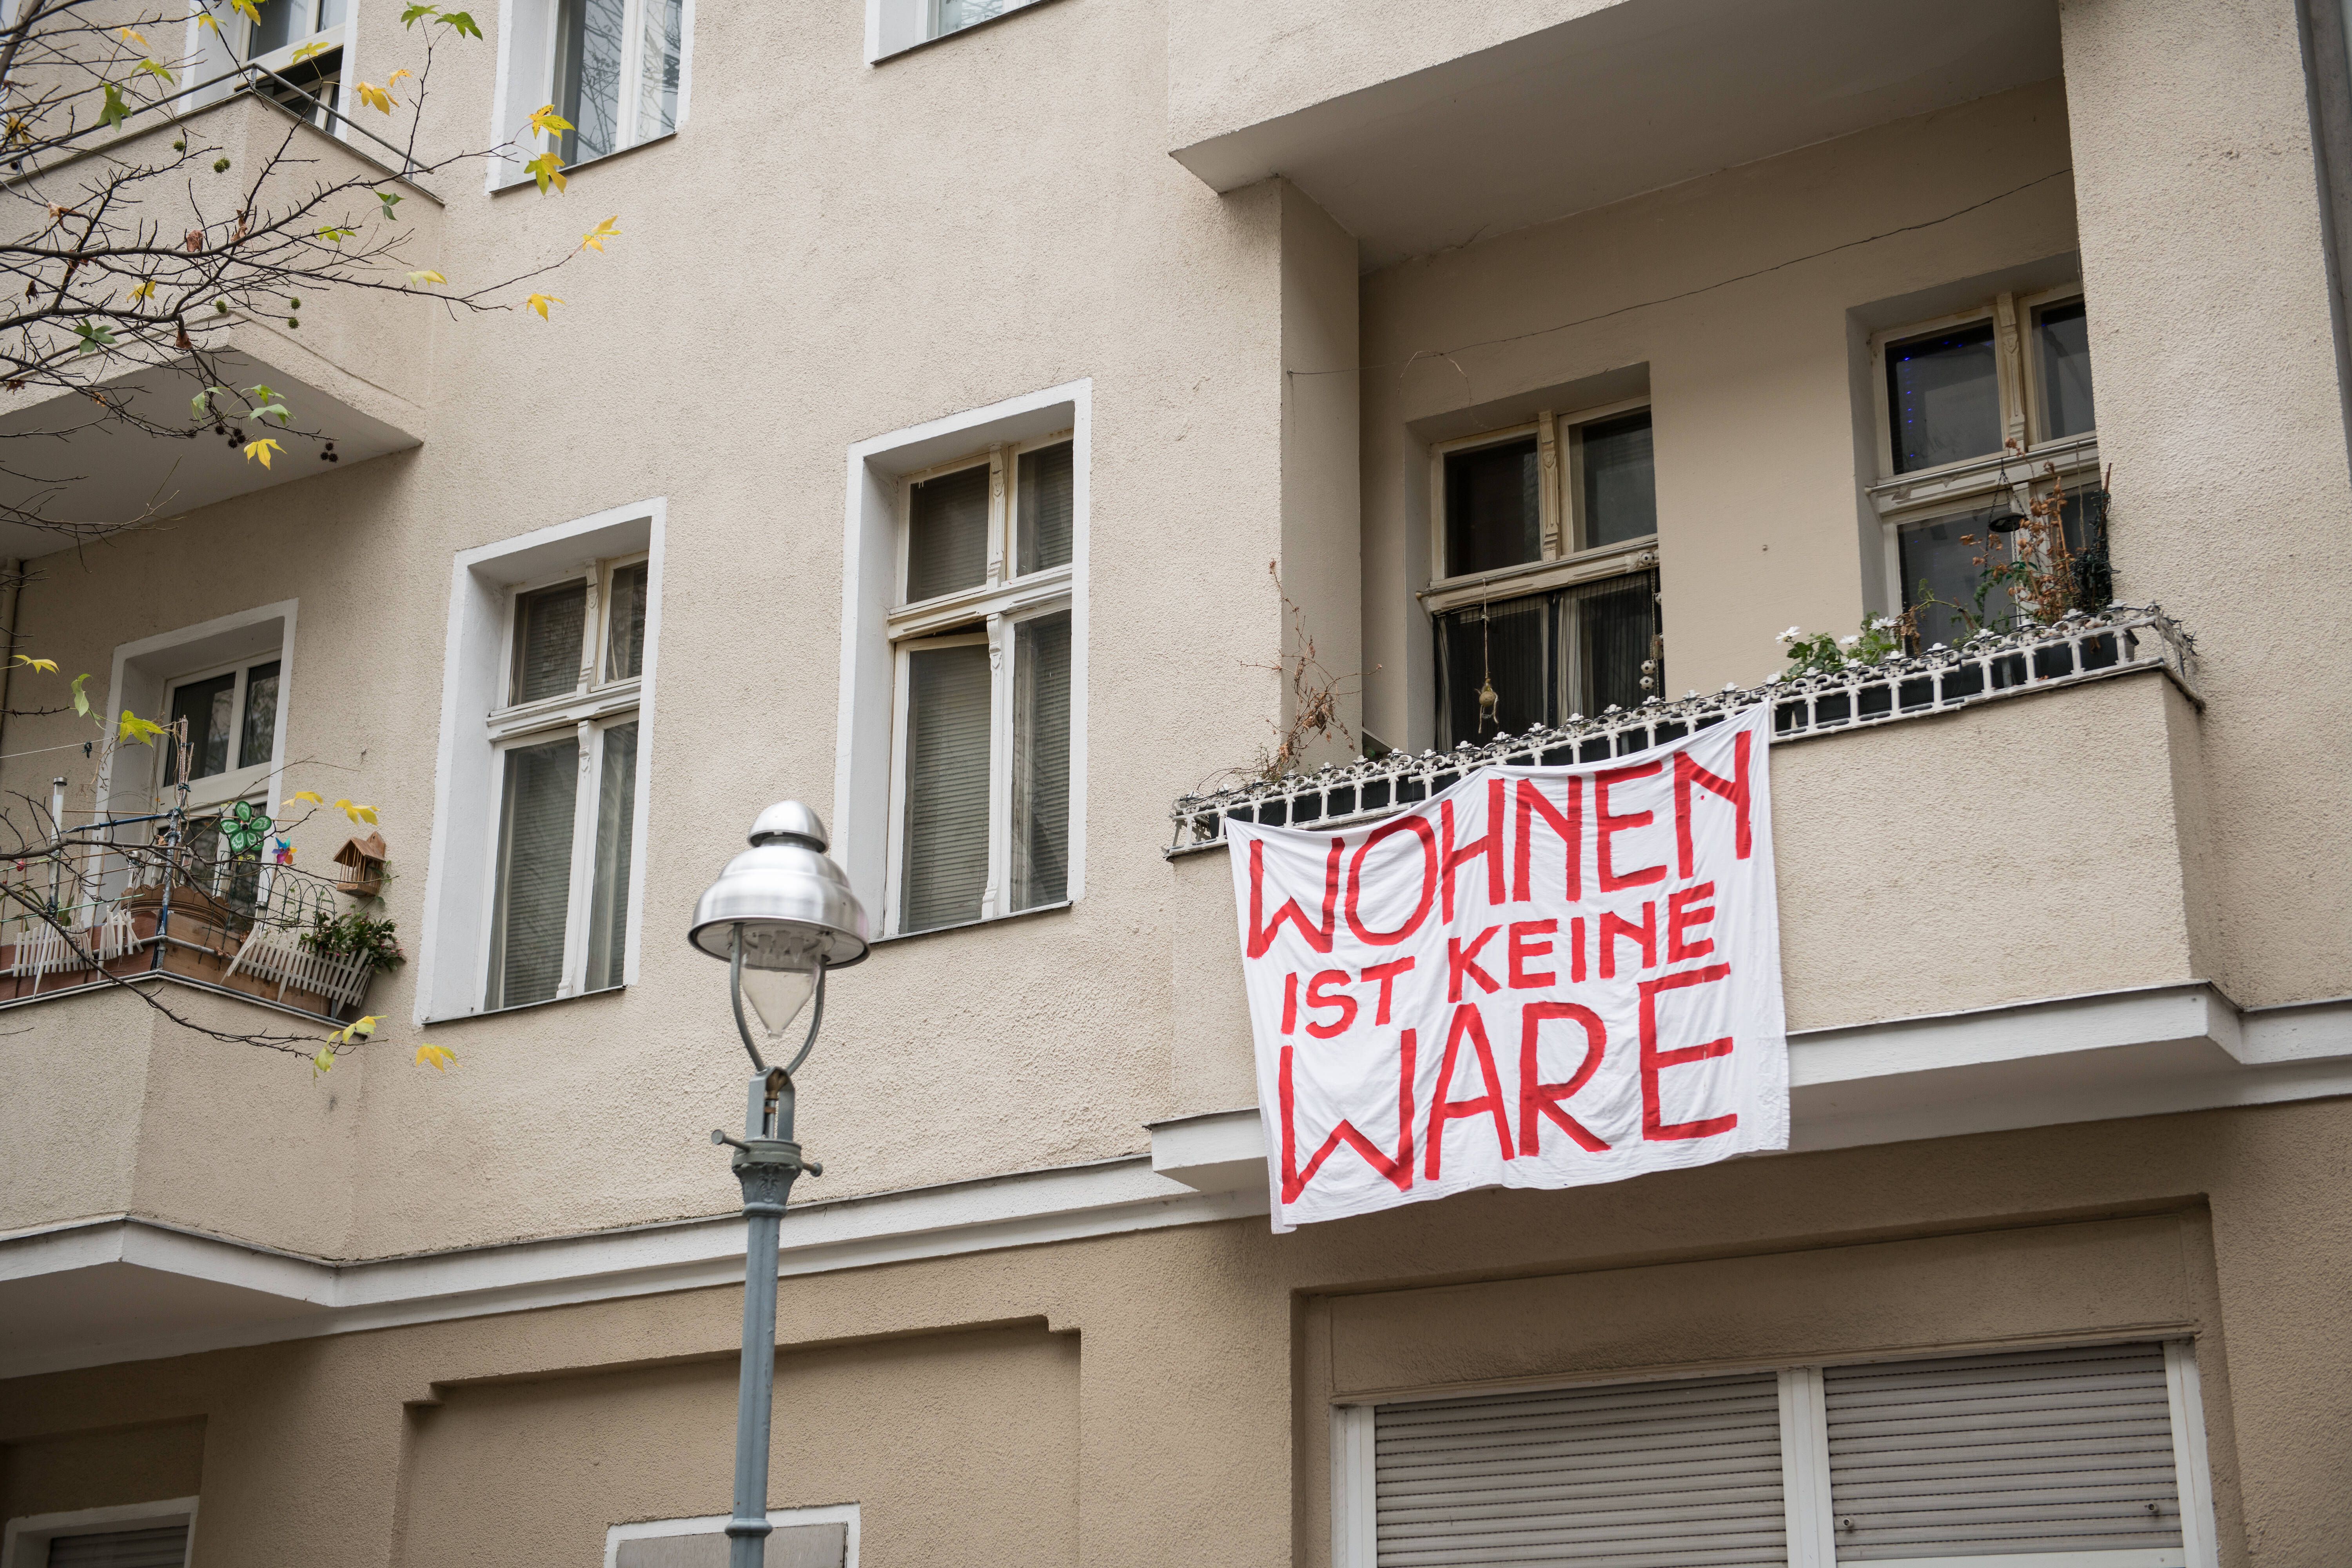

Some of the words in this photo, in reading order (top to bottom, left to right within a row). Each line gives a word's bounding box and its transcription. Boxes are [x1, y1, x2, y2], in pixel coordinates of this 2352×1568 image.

[1247, 730, 1752, 959] WOHNEN
[1281, 956, 1415, 1039] IST
[1448, 881, 1715, 1003] KEINE
[1279, 962, 1737, 1204] WARE
